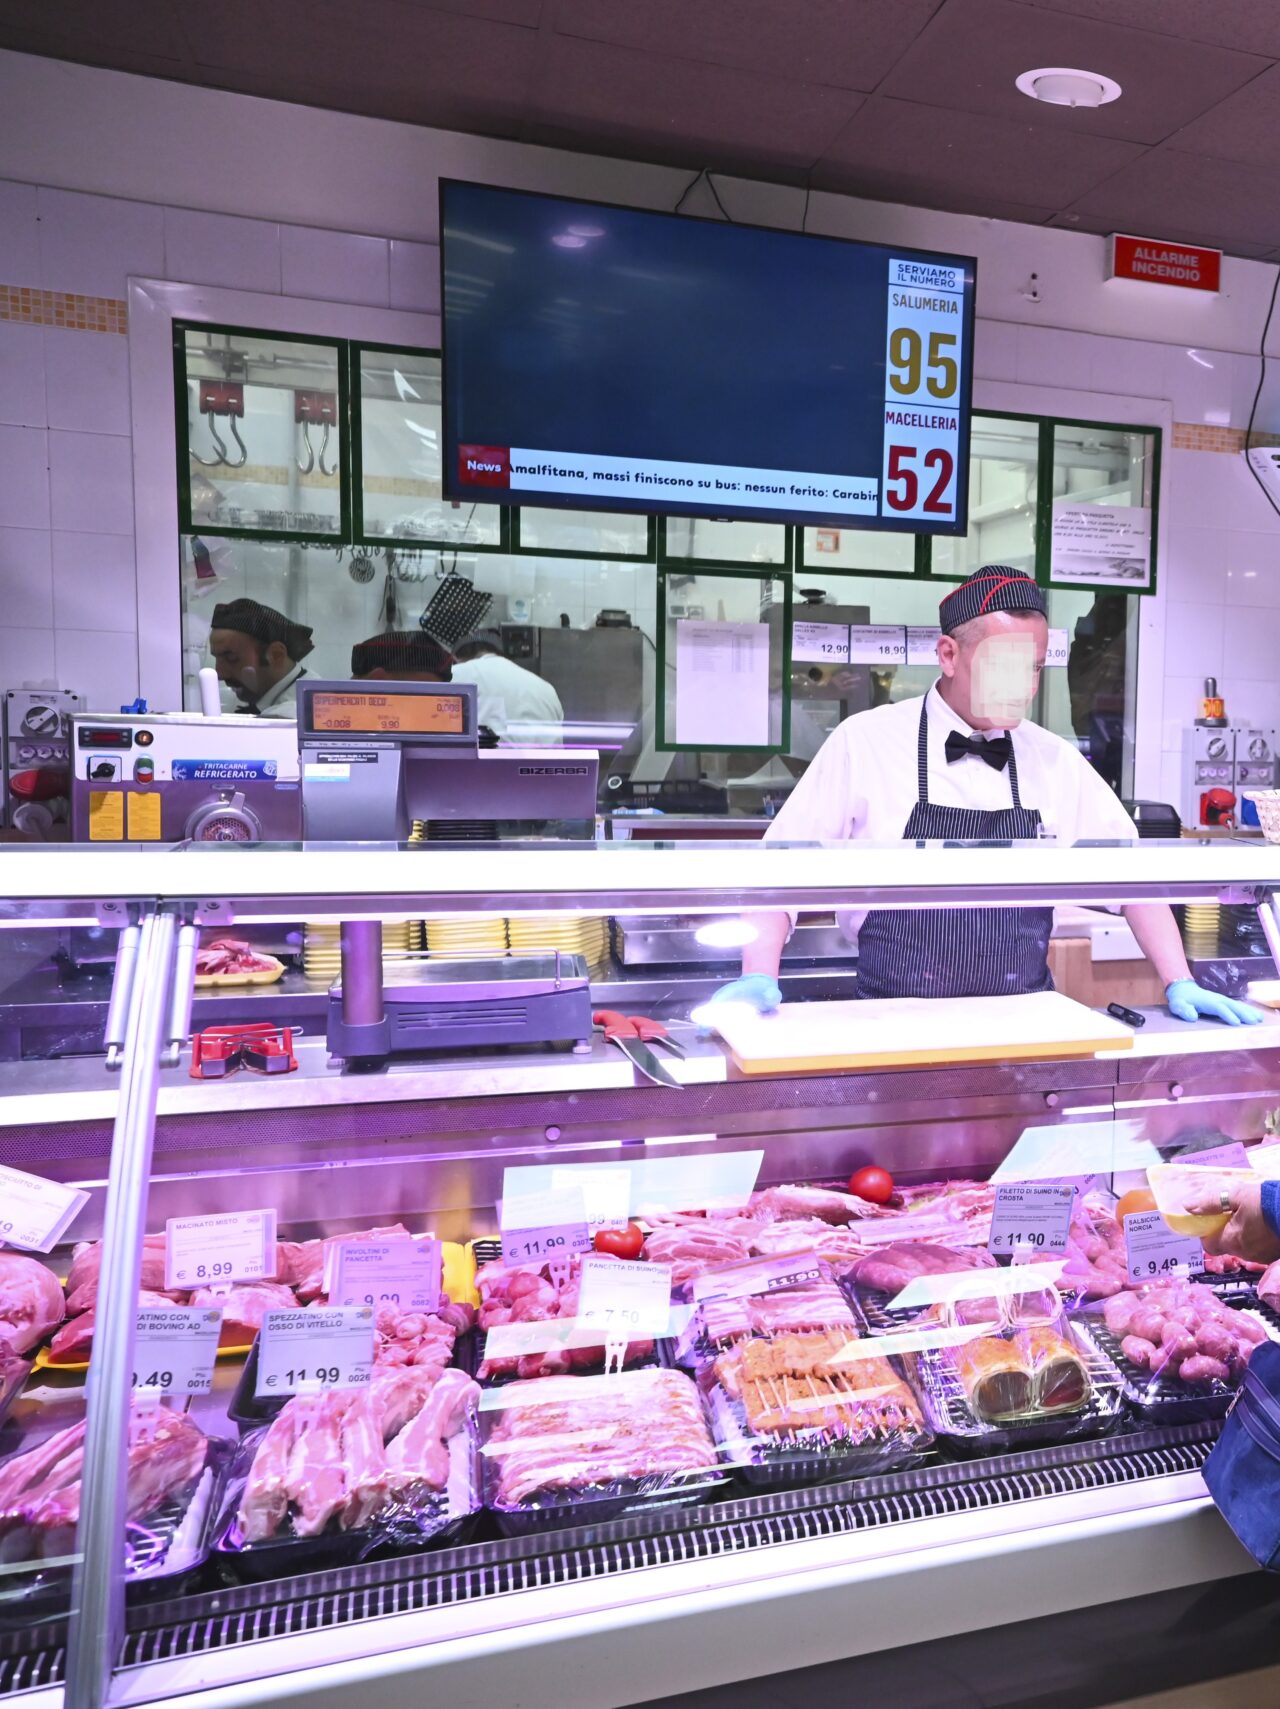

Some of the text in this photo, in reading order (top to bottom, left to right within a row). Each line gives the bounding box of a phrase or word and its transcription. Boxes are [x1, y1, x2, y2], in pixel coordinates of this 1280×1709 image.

[1134, 247, 1199, 268] ALLARME
[897, 264, 956, 280] SERVIAMO
[1132, 261, 1200, 282] INCENDIO
[897, 273, 956, 288] IL NUMERO
[892, 293, 959, 314] SALUMERIA
[888, 327, 958, 399] 95
[885, 411, 957, 431] MACELLERIA
[467, 460, 502, 472] News
[593, 470, 630, 482] massi
[635, 472, 694, 488] finiscono
[699, 480, 711, 488] su
[715, 479, 741, 491] bus:
[745, 484, 786, 494] nessun
[790, 485, 829, 498] ferito:
[886, 445, 954, 514] 52
[821, 644, 849, 654] 12,90
[879, 646, 906, 655] 18,90
[194, 770, 257, 779] REFRIGERATO
[519, 767, 588, 776] BIZERBA
[176, 1218, 238, 1230] MACINATO MISTO
[1129, 1216, 1161, 1226] SALSICCIA
[1129, 1225, 1152, 1233] NORCIA
[993, 1232, 1046, 1246] € 1190
[508, 1248, 519, 1258] €
[176, 1262, 232, 1280] € 8,99
[589, 1263, 625, 1271] PANCETTA
[637, 1265, 657, 1273] SUINO
[1133, 1257, 1178, 1277] € 9,49
[269, 1313, 322, 1322] SPEZZATINO
[605, 1309, 640, 1324] 750
[269, 1320, 343, 1331] OSSO DI VITELLO
[265, 1367, 340, 1387] € 1199
